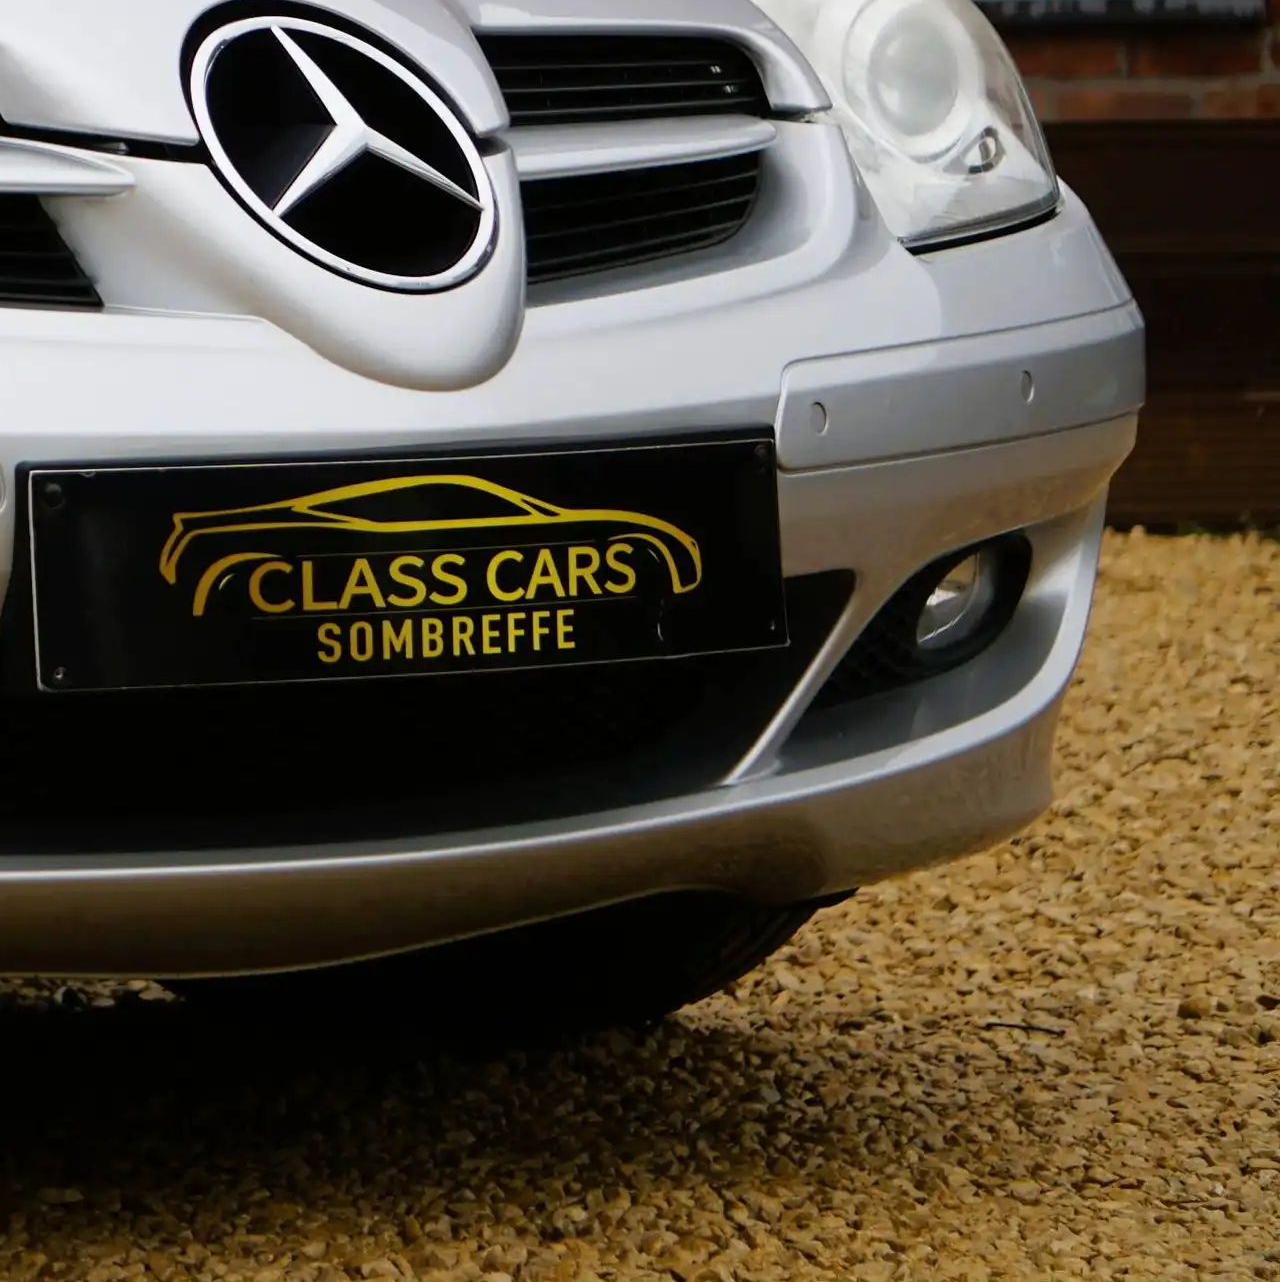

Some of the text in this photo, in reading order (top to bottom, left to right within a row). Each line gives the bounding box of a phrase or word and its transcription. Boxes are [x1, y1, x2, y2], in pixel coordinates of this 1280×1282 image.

[248, 541, 638, 614] CLASS CARS
[316, 607, 577, 664] SOMBREFFE
